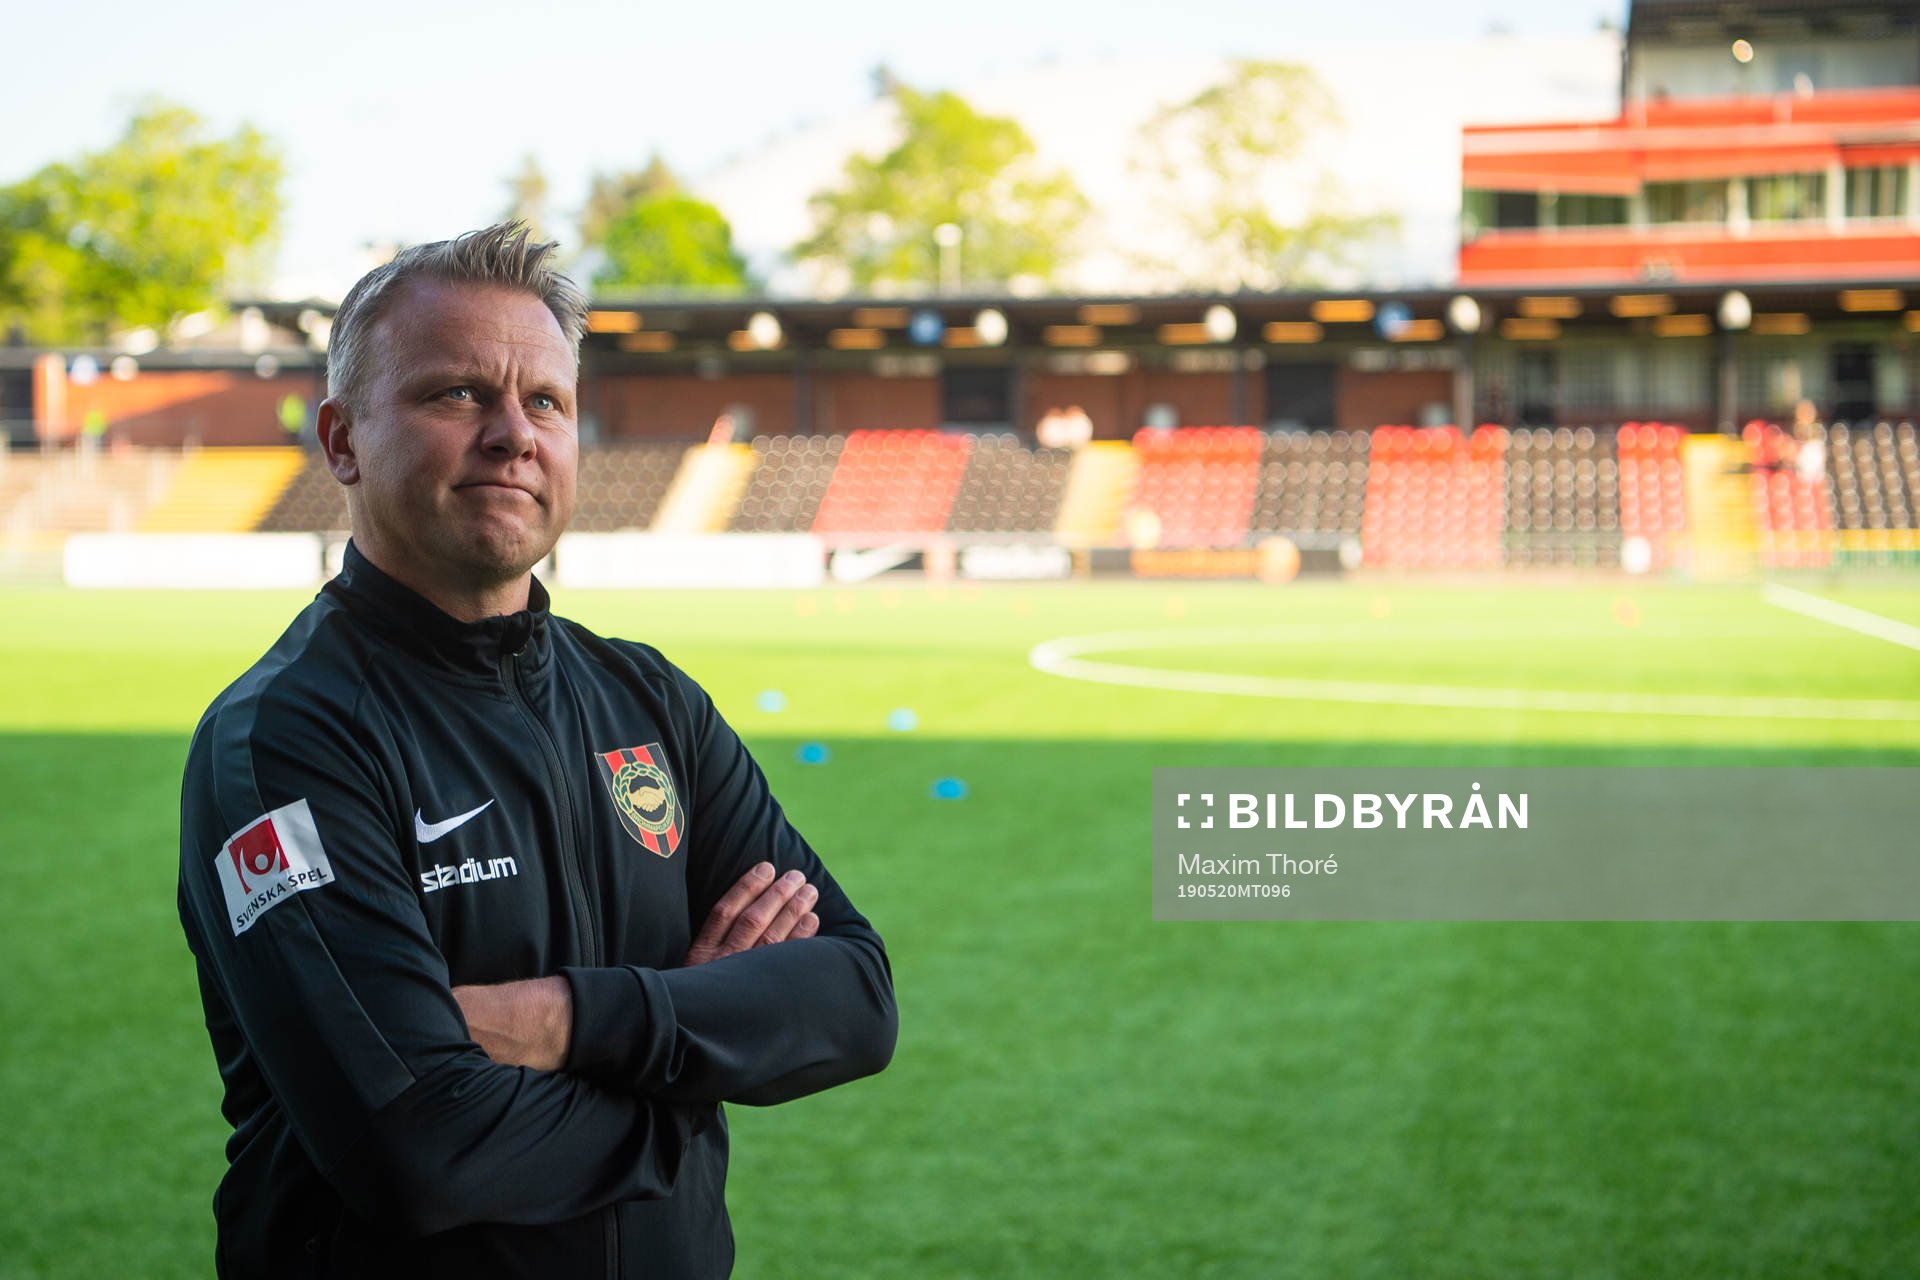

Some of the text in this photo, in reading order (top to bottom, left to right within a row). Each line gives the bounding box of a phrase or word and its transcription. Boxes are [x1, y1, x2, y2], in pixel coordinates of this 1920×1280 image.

[236, 867, 328, 928] SVENSKA SPEL
[420, 856, 518, 893] stadium
